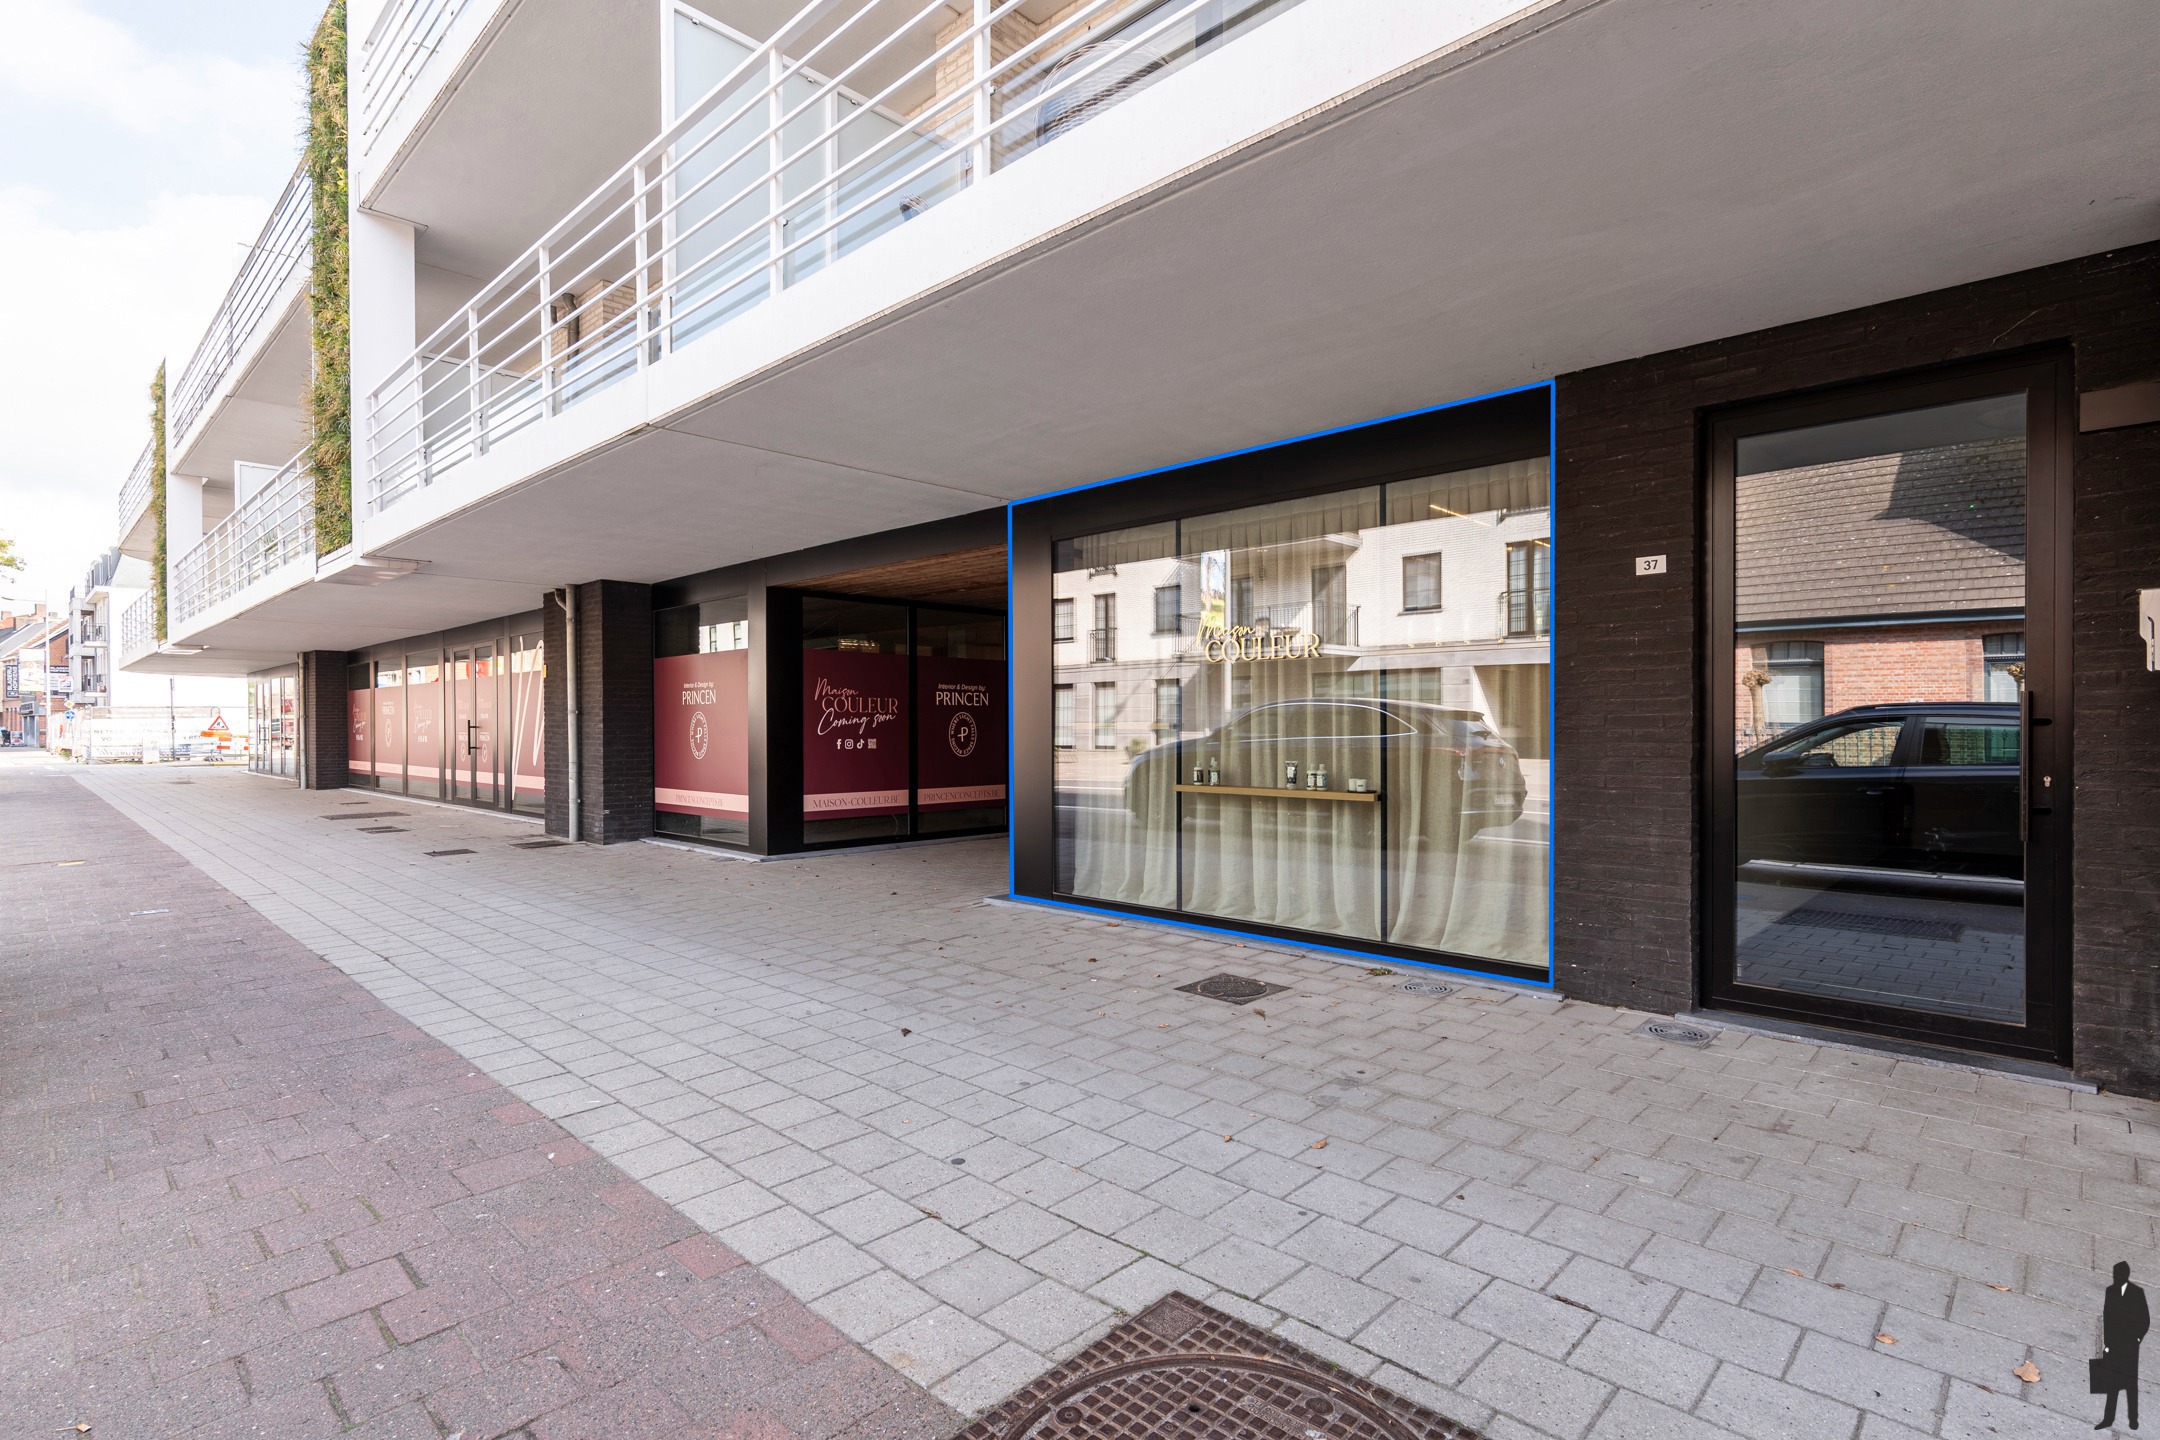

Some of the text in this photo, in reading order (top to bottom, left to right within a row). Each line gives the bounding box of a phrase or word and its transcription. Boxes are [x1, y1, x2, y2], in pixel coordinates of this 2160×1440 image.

[1643, 559, 1658, 571] 37
[1195, 613, 1257, 647] Maison
[1204, 632, 1322, 664] COULEUR
[682, 689, 716, 705] PRINCEN
[814, 677, 858, 701] Maison
[961, 684, 978, 692] Design
[822, 696, 898, 714] COULEUR
[935, 691, 989, 706] PRINCEN
[817, 707, 896, 736] Coming soon
